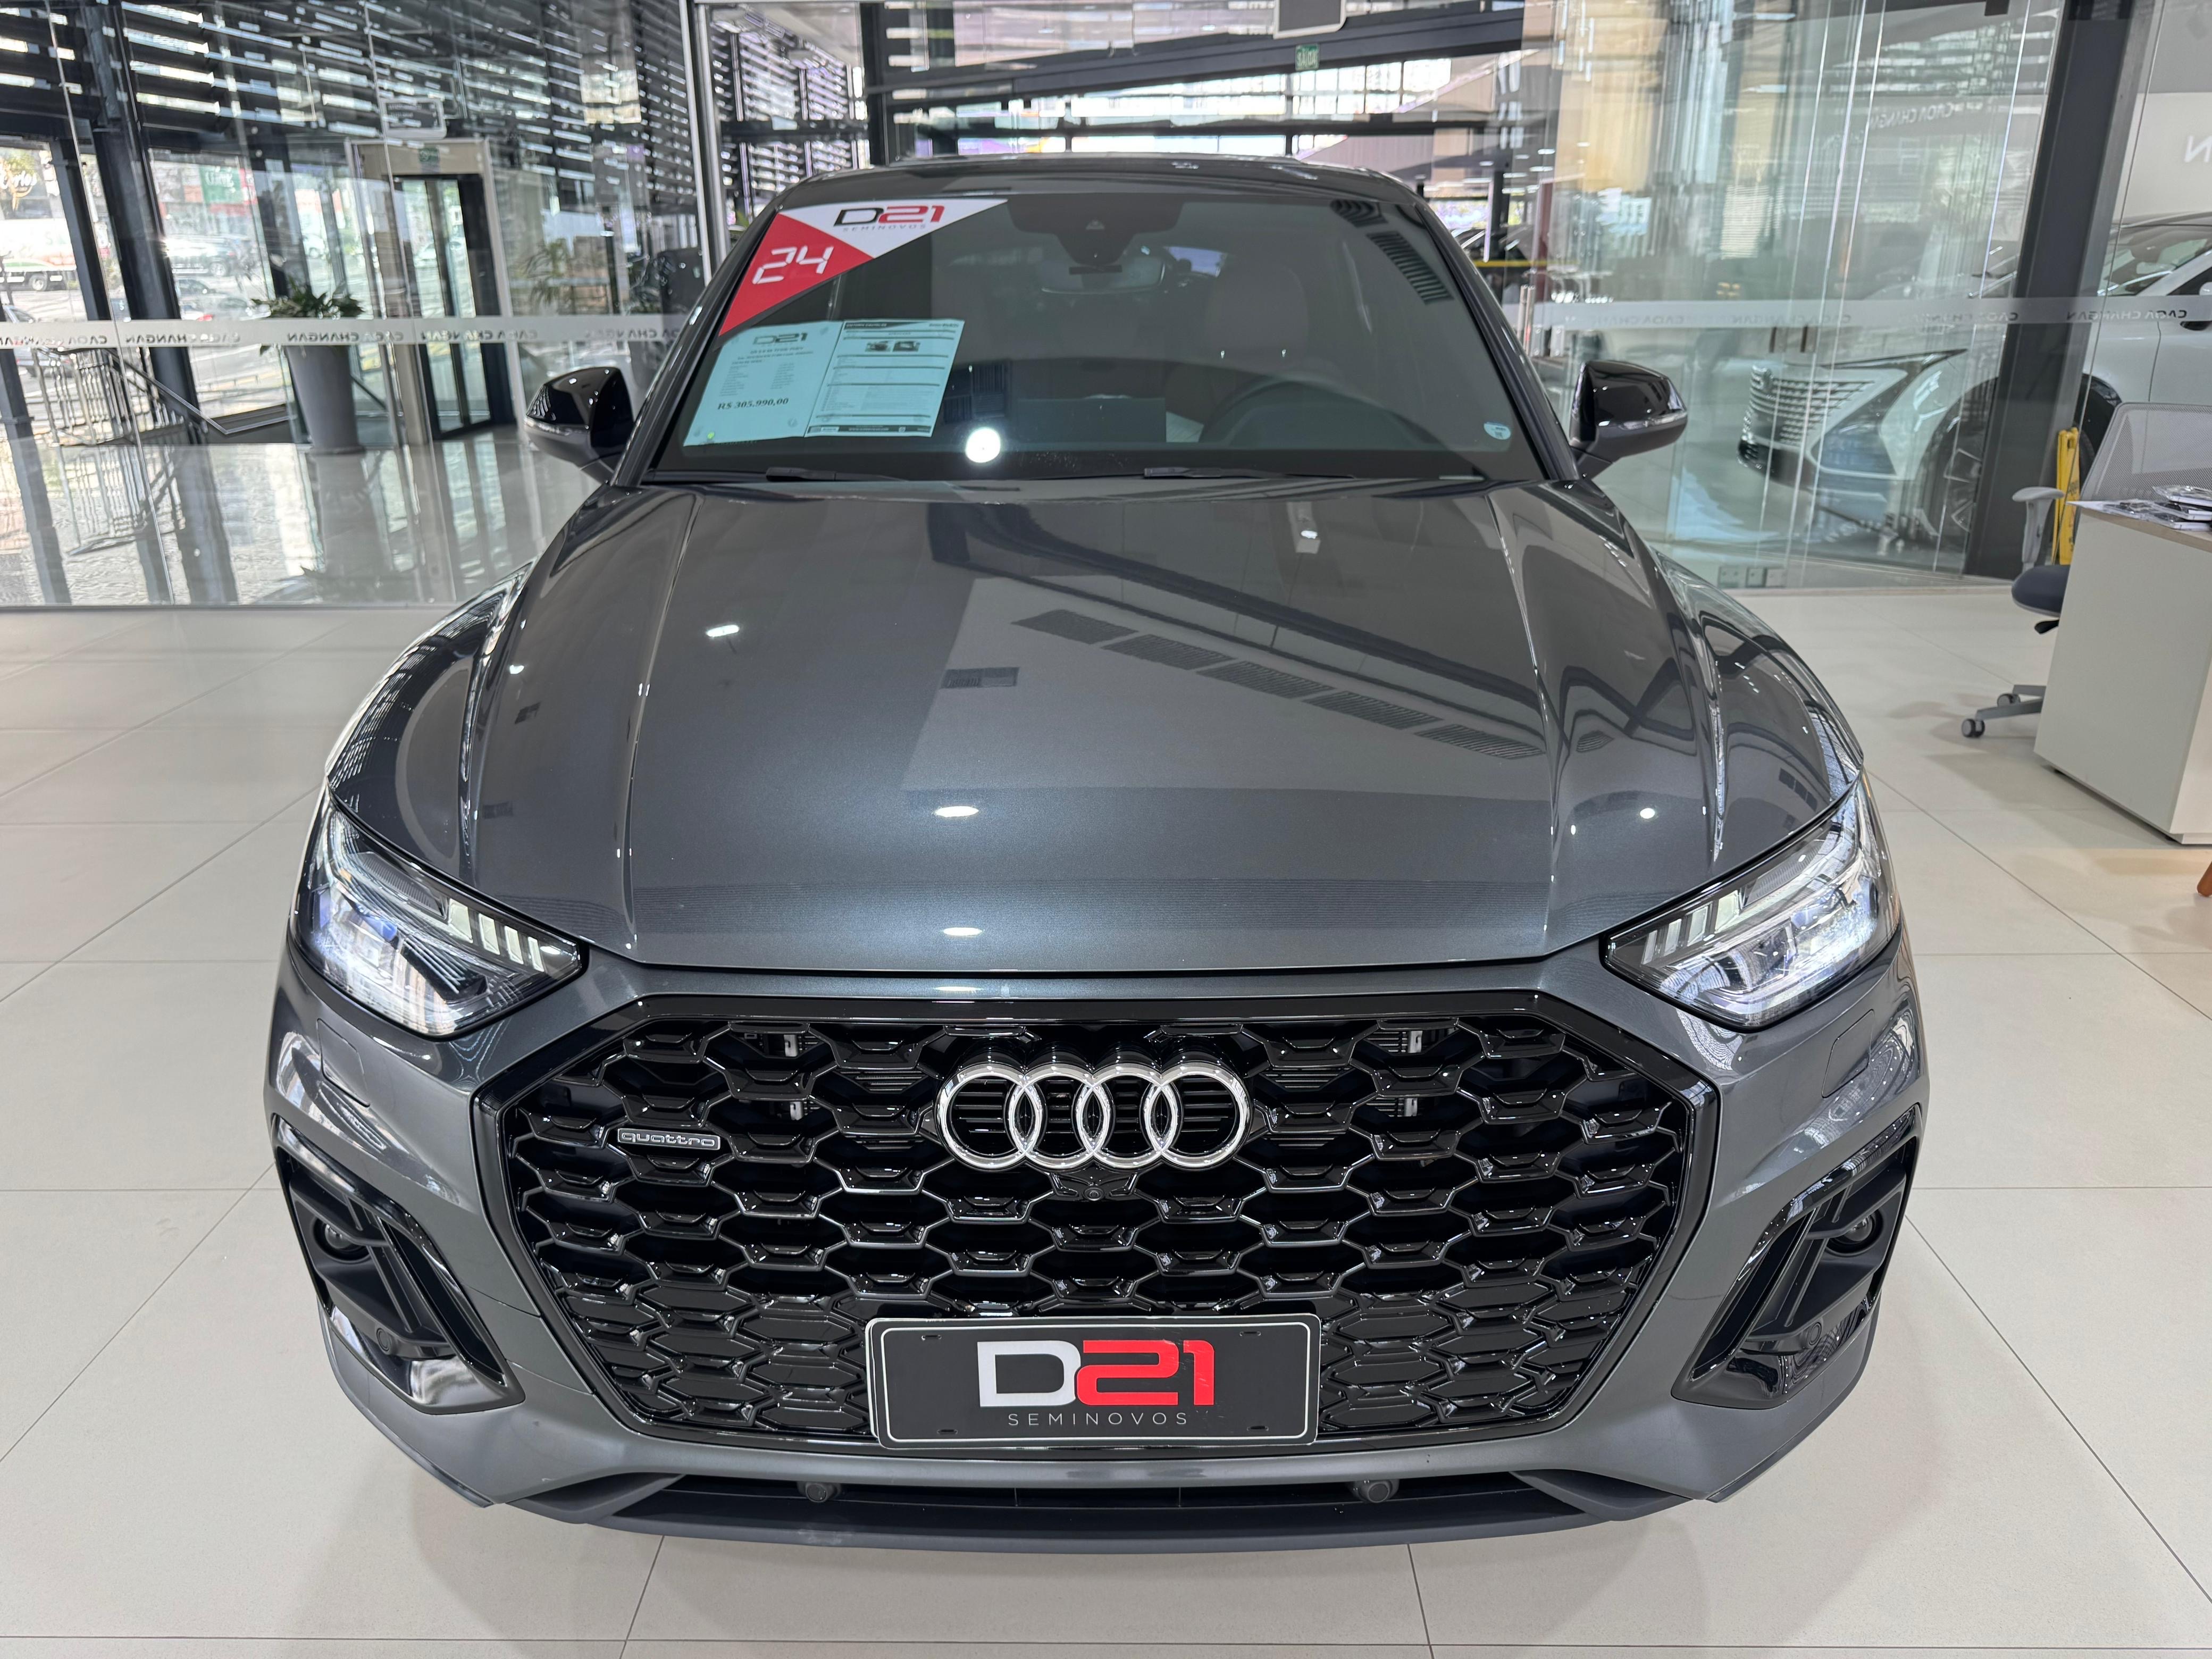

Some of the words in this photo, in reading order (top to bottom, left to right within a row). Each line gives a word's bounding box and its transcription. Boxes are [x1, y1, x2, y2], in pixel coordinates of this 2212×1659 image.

[833, 205, 945, 227] D21
[752, 245, 834, 284] 24
[622, 1132, 715, 1146] quattro
[977, 1340, 1215, 1407] D21
[1008, 1412, 1187, 1427] SEMINOVOS
